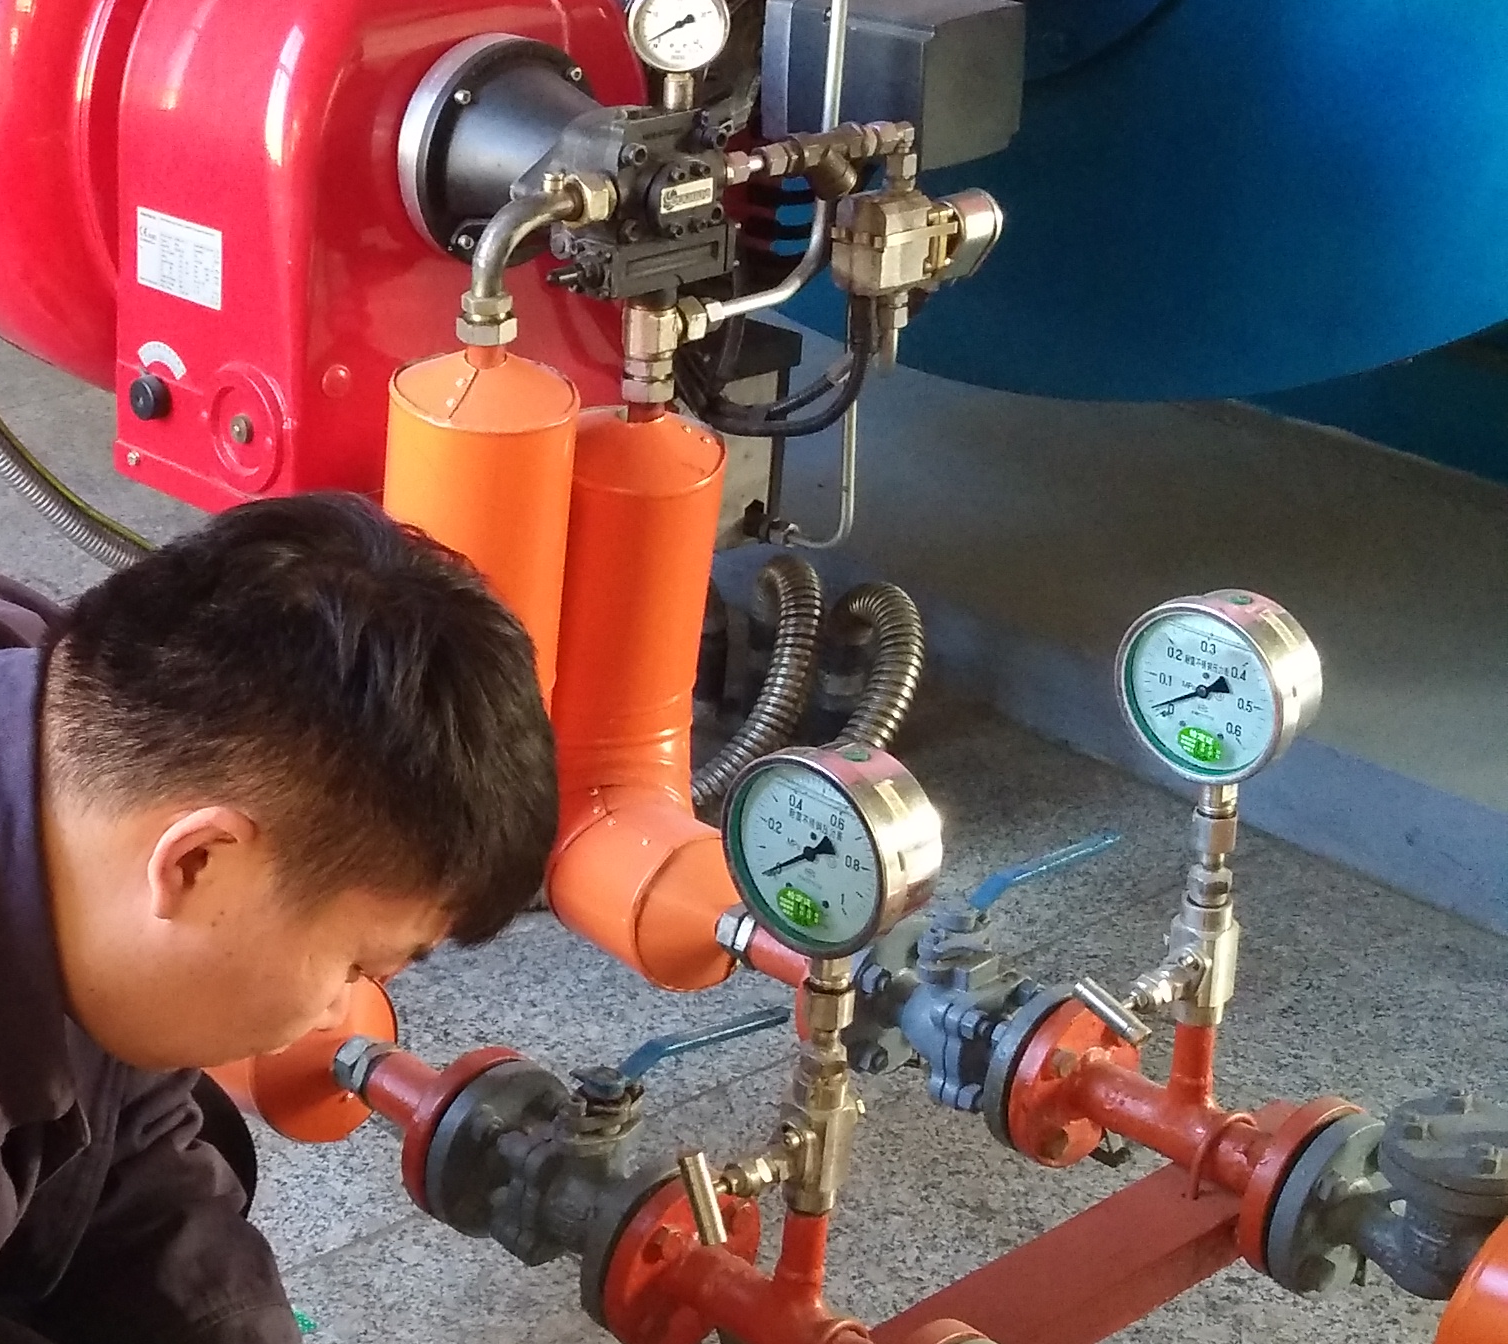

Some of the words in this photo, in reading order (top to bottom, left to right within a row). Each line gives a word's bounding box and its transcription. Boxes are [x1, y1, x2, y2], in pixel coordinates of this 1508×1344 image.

[1167, 646, 1183, 662] 0.2
[1200, 640, 1217, 655] 0.3
[1159, 672, 1173, 687] 0.1
[1230, 666, 1247, 681] 0.4
[1237, 697, 1253, 713] 0.5
[1225, 721, 1242, 737] 0.6
[789, 794, 803, 811] 0.4
[767, 817, 783, 835] 0.2
[829, 813, 845, 831] 0.6
[845, 854, 861, 872] 0.8
